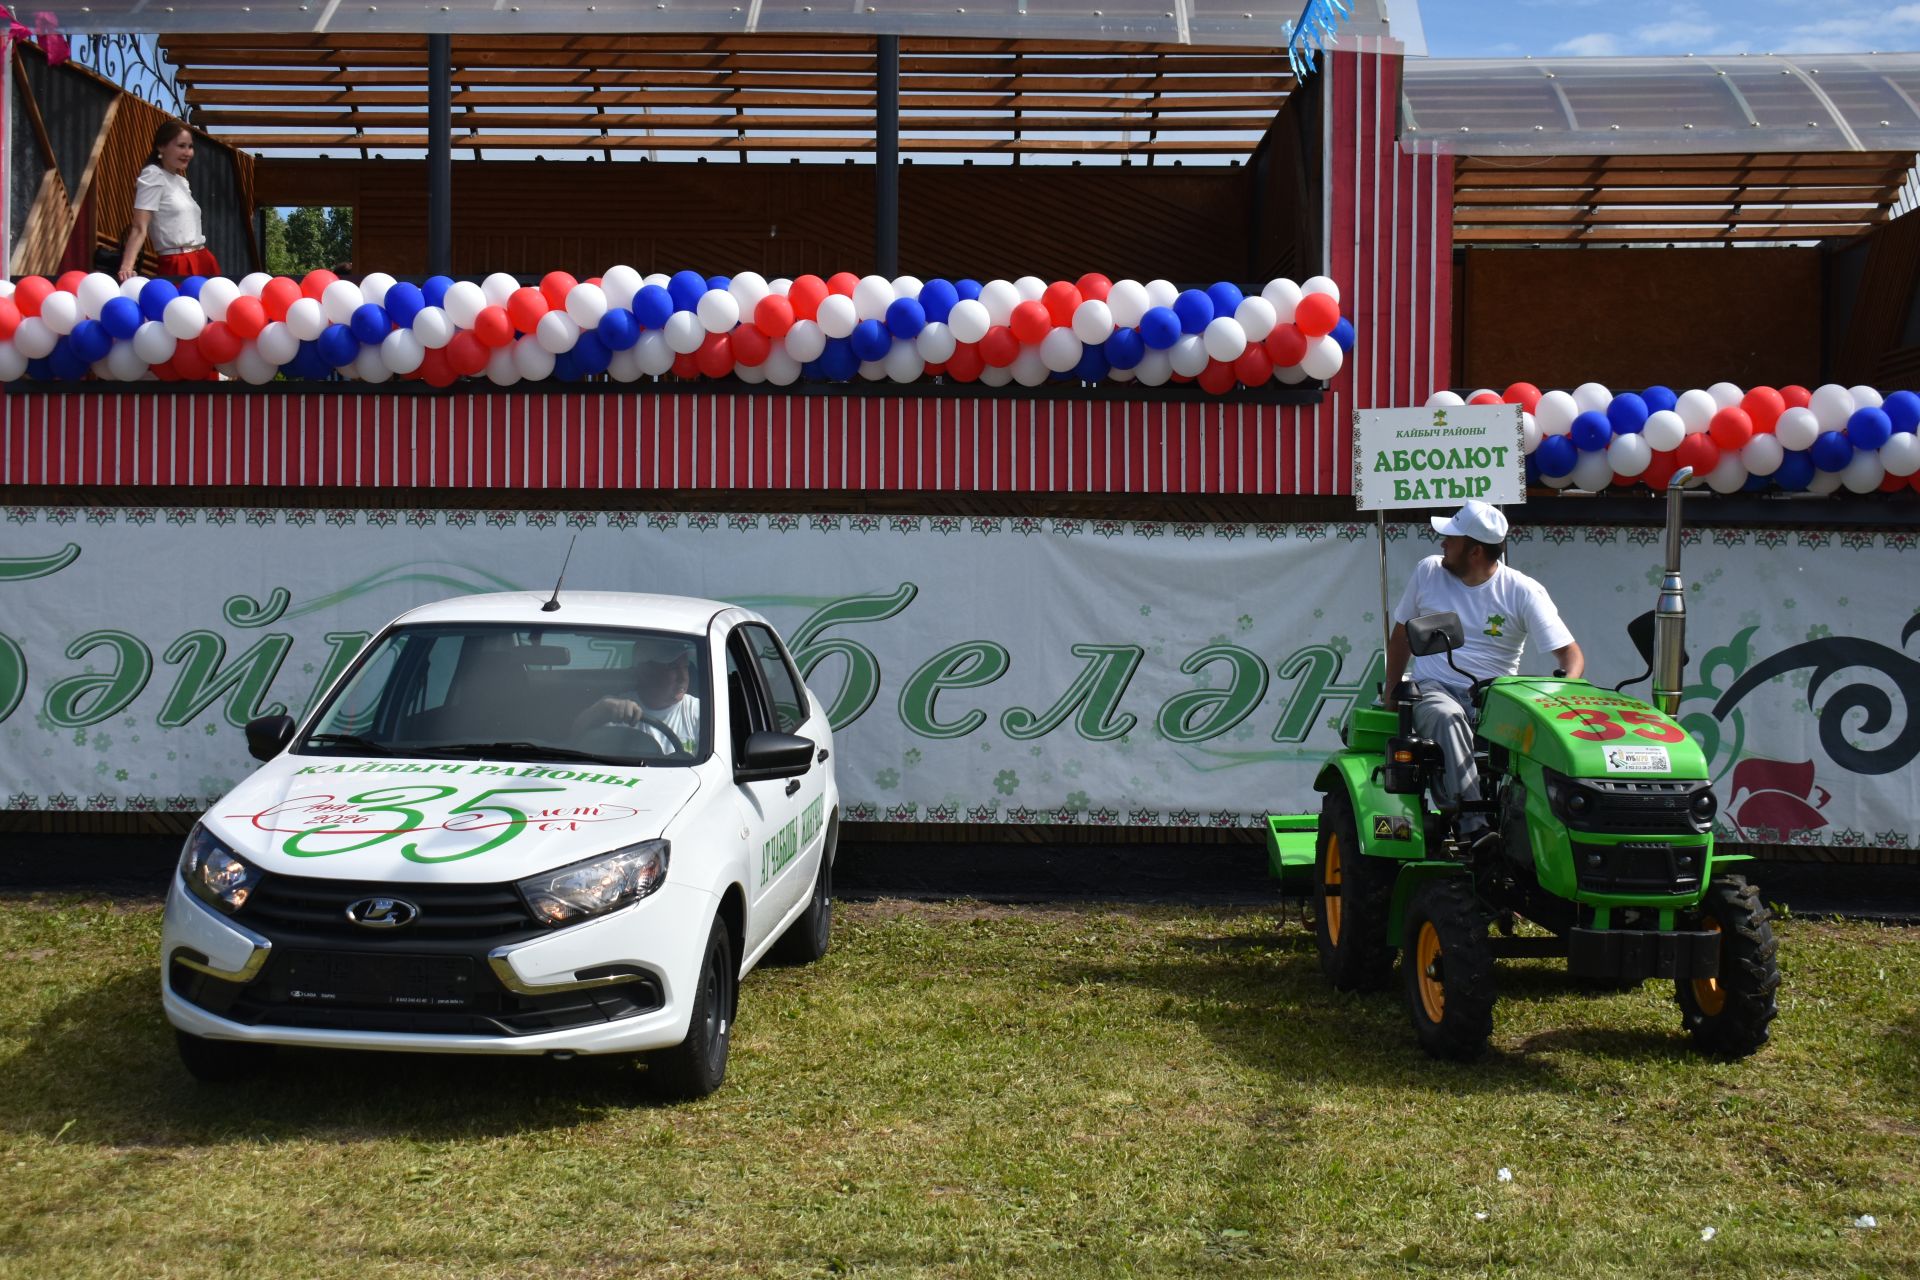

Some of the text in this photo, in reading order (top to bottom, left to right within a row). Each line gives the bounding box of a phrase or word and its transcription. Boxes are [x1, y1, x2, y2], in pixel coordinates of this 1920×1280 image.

[1396, 426, 1487, 439] КАЙБЫЧ РАЙОНЫ
[1374, 446, 1509, 473] АБСОЛЮТ
[1393, 475, 1492, 501] БАТЫР
[1556, 708, 1685, 744] 35
[292, 761, 645, 788] КАЙБЫЧ РАЙОНЫ
[282, 785, 567, 864] 35
